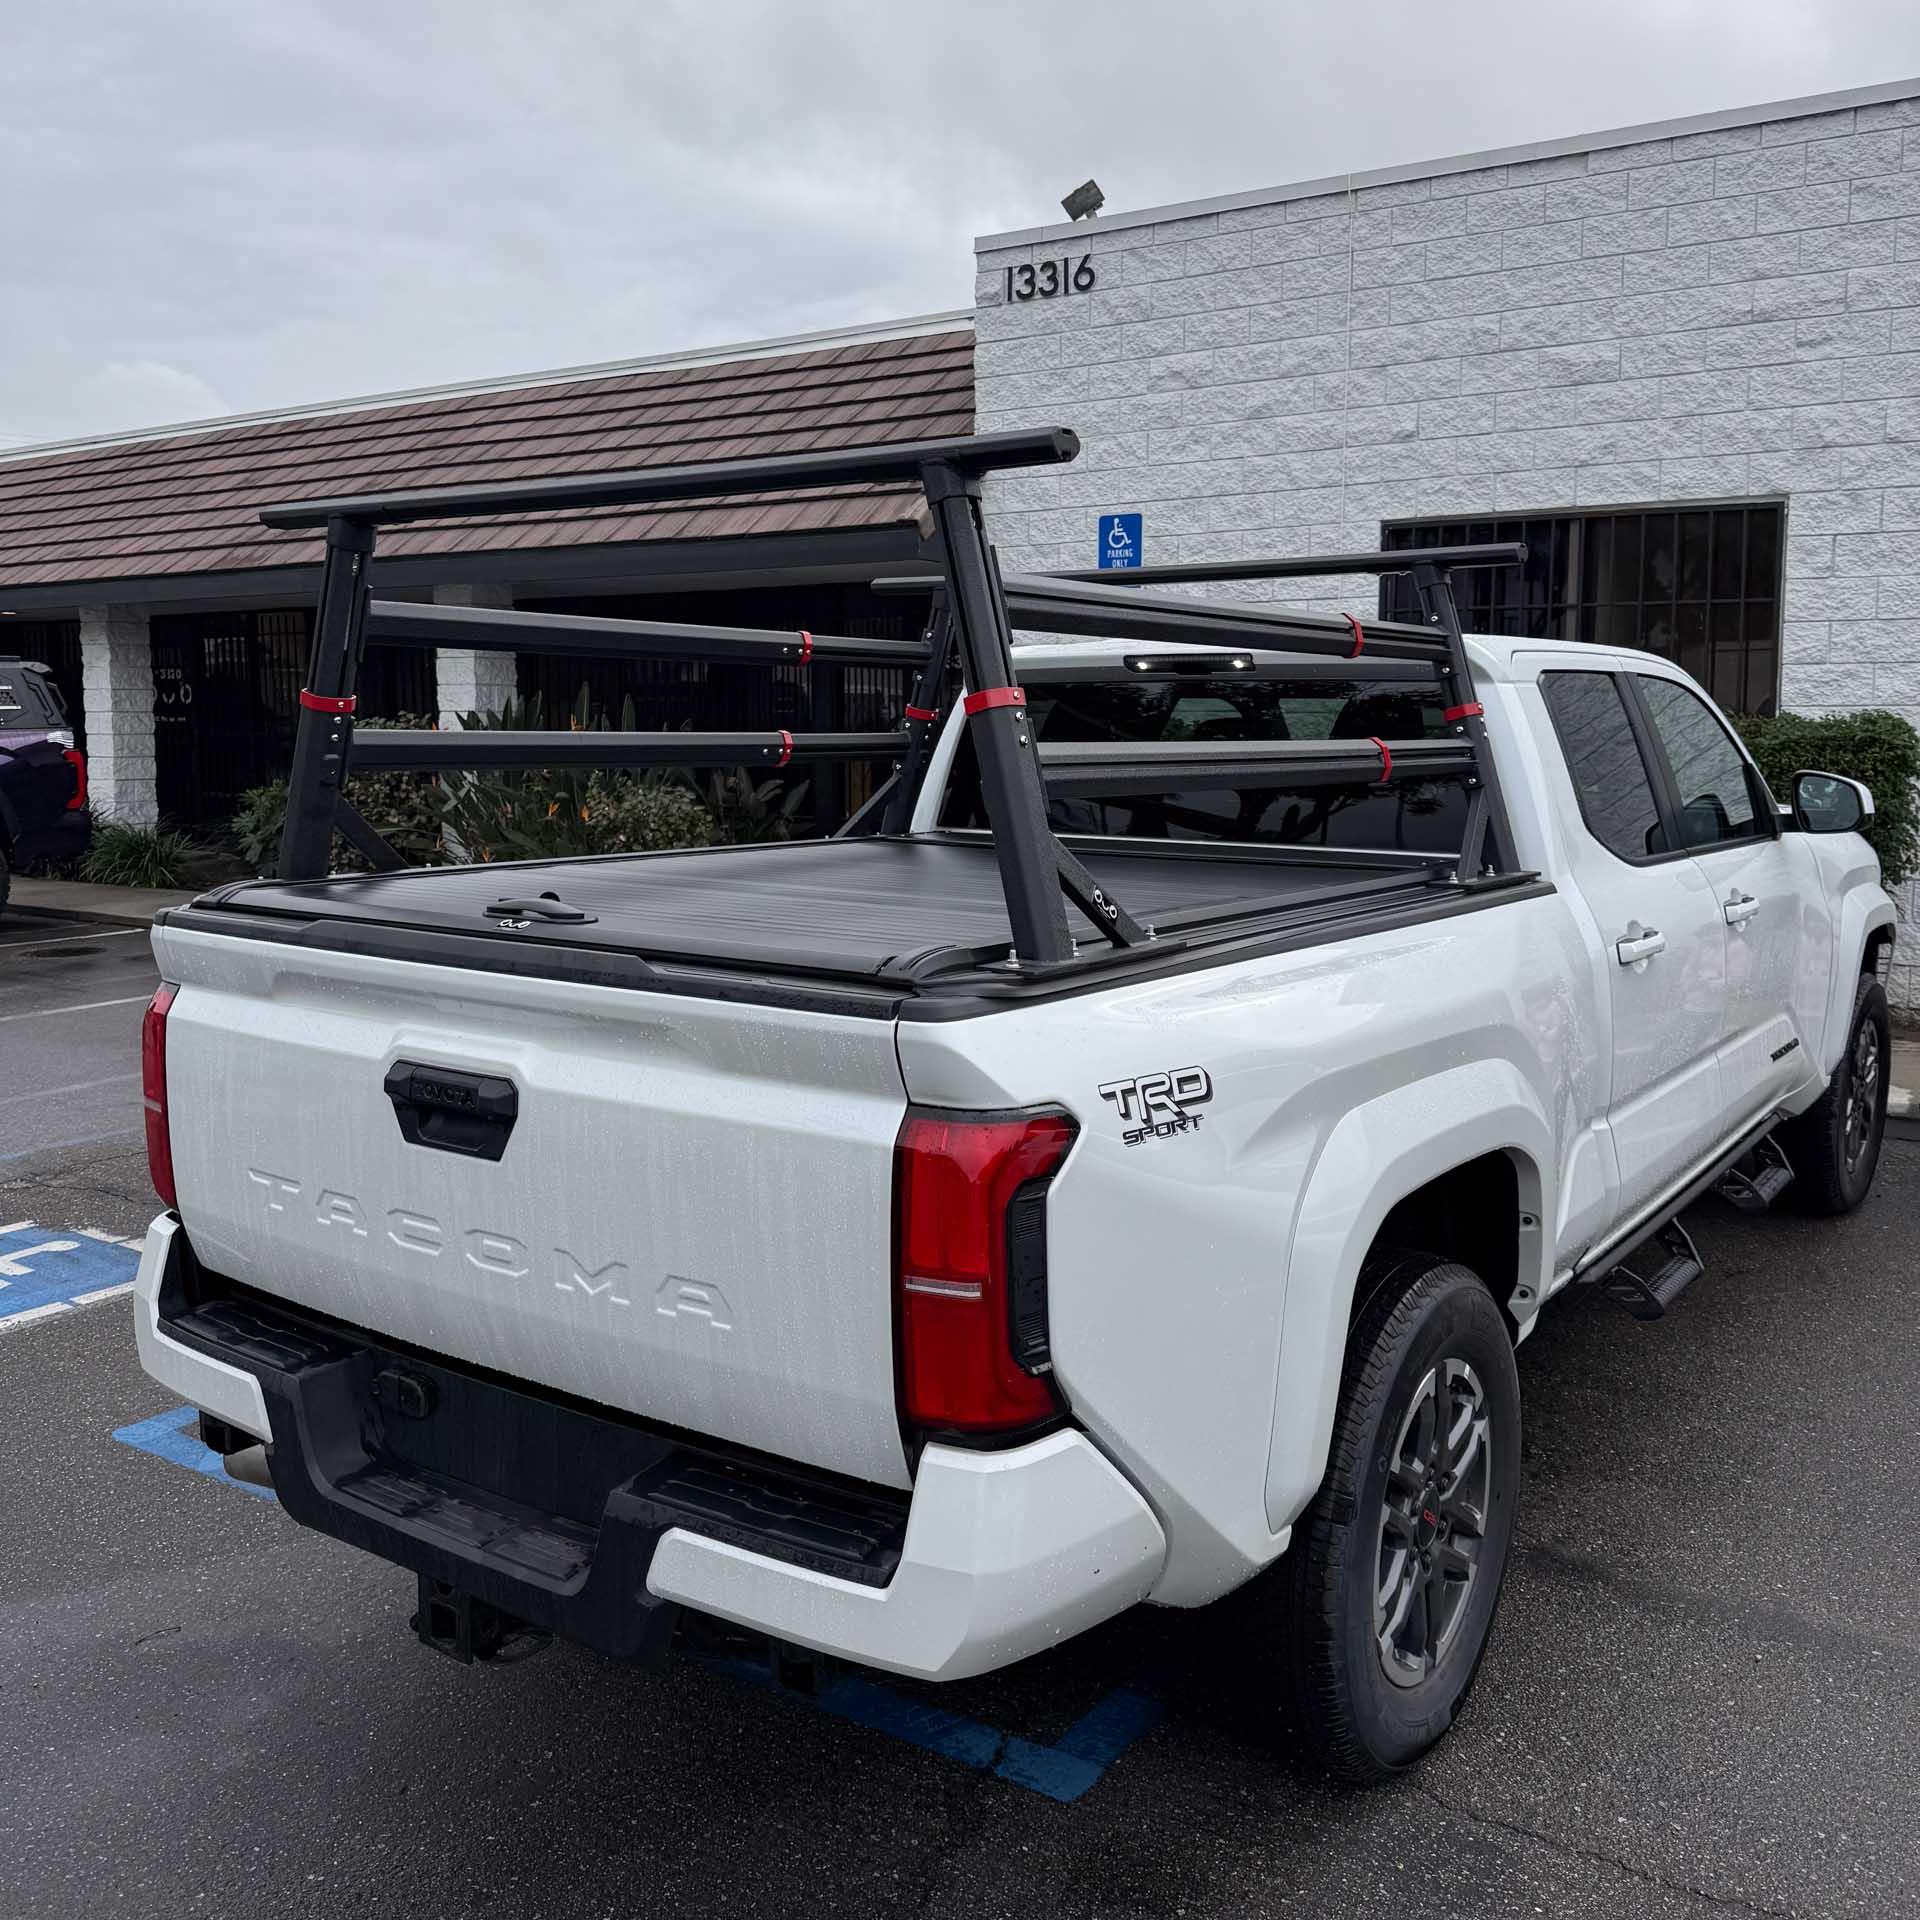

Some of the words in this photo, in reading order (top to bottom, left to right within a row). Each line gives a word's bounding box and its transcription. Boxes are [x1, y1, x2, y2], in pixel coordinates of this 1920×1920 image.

[1007, 253, 1096, 302] 13316
[1107, 549, 1133, 559] PARKING
[1111, 559, 1129, 568] ONLY
[1098, 1065, 1213, 1126] TRD
[1122, 1114, 1204, 1147] SPORT
[248, 1167, 732, 1329] TACOMA
